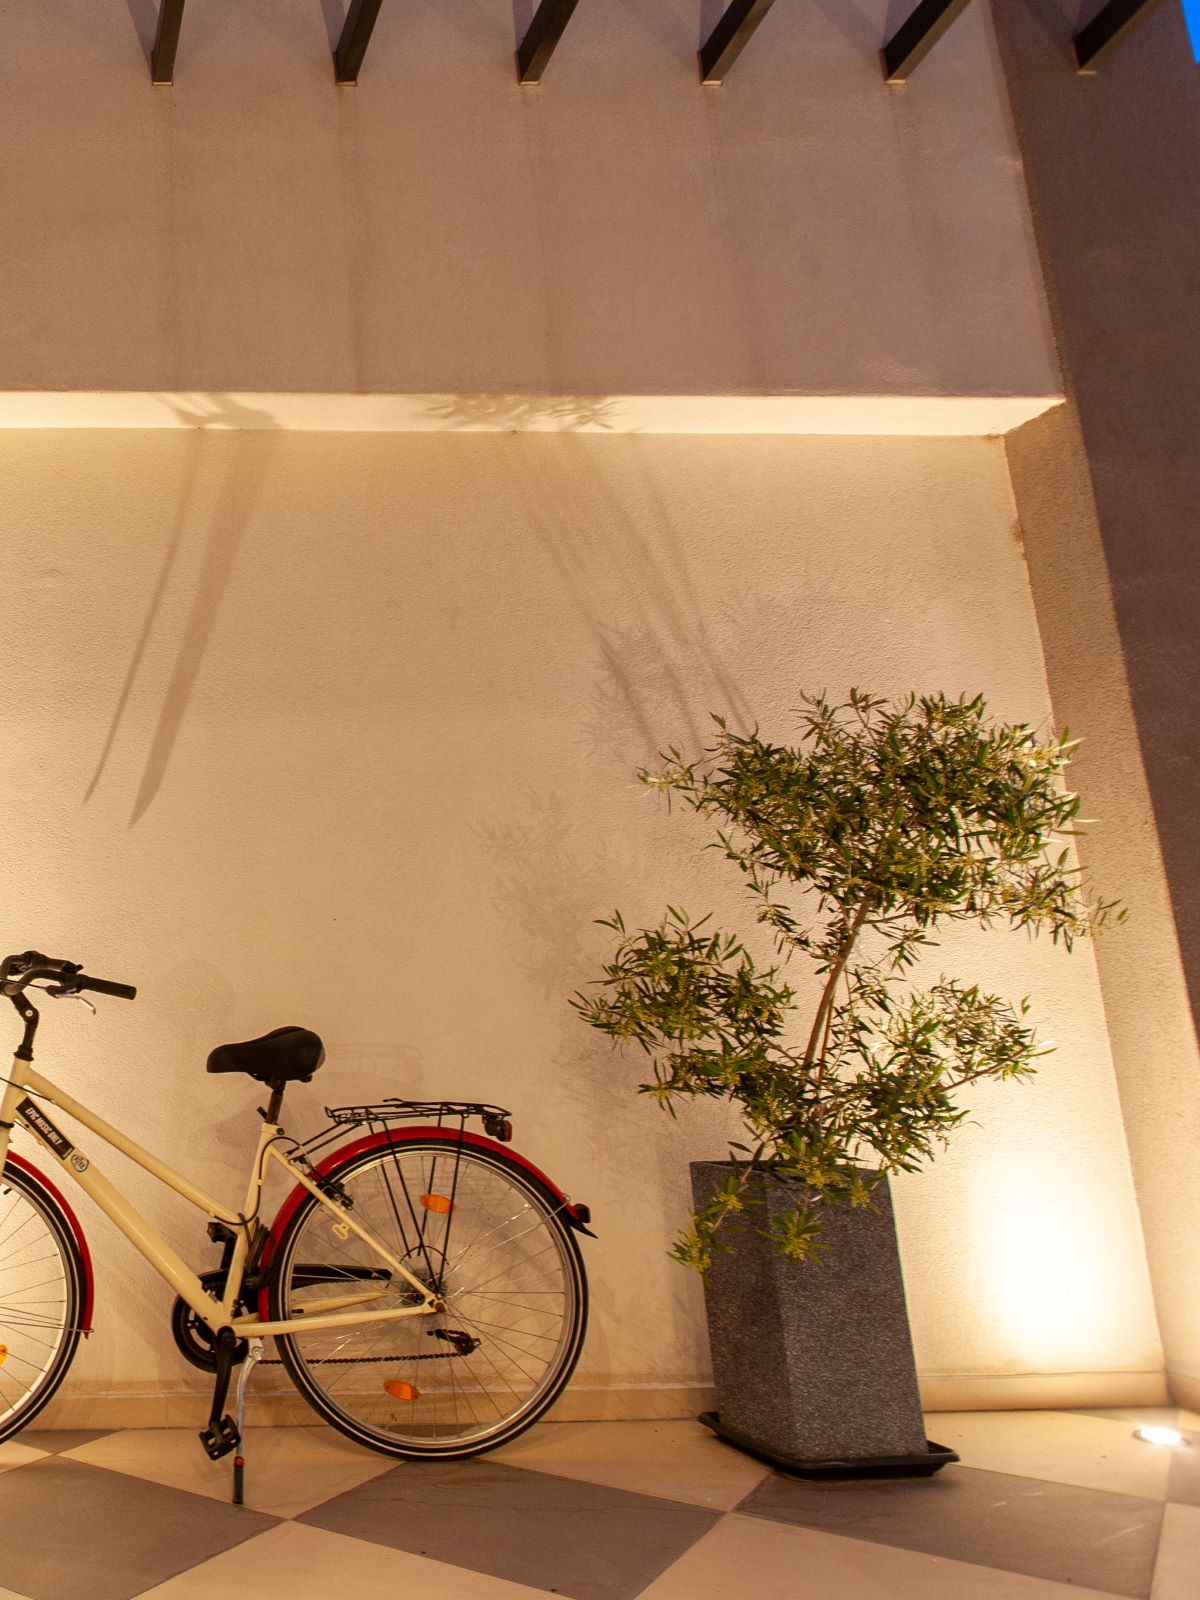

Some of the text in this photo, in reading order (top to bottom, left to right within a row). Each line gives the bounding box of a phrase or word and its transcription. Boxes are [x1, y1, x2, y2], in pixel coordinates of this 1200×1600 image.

[25, 1107, 64, 1145] EPIC MUSIC ONLY
